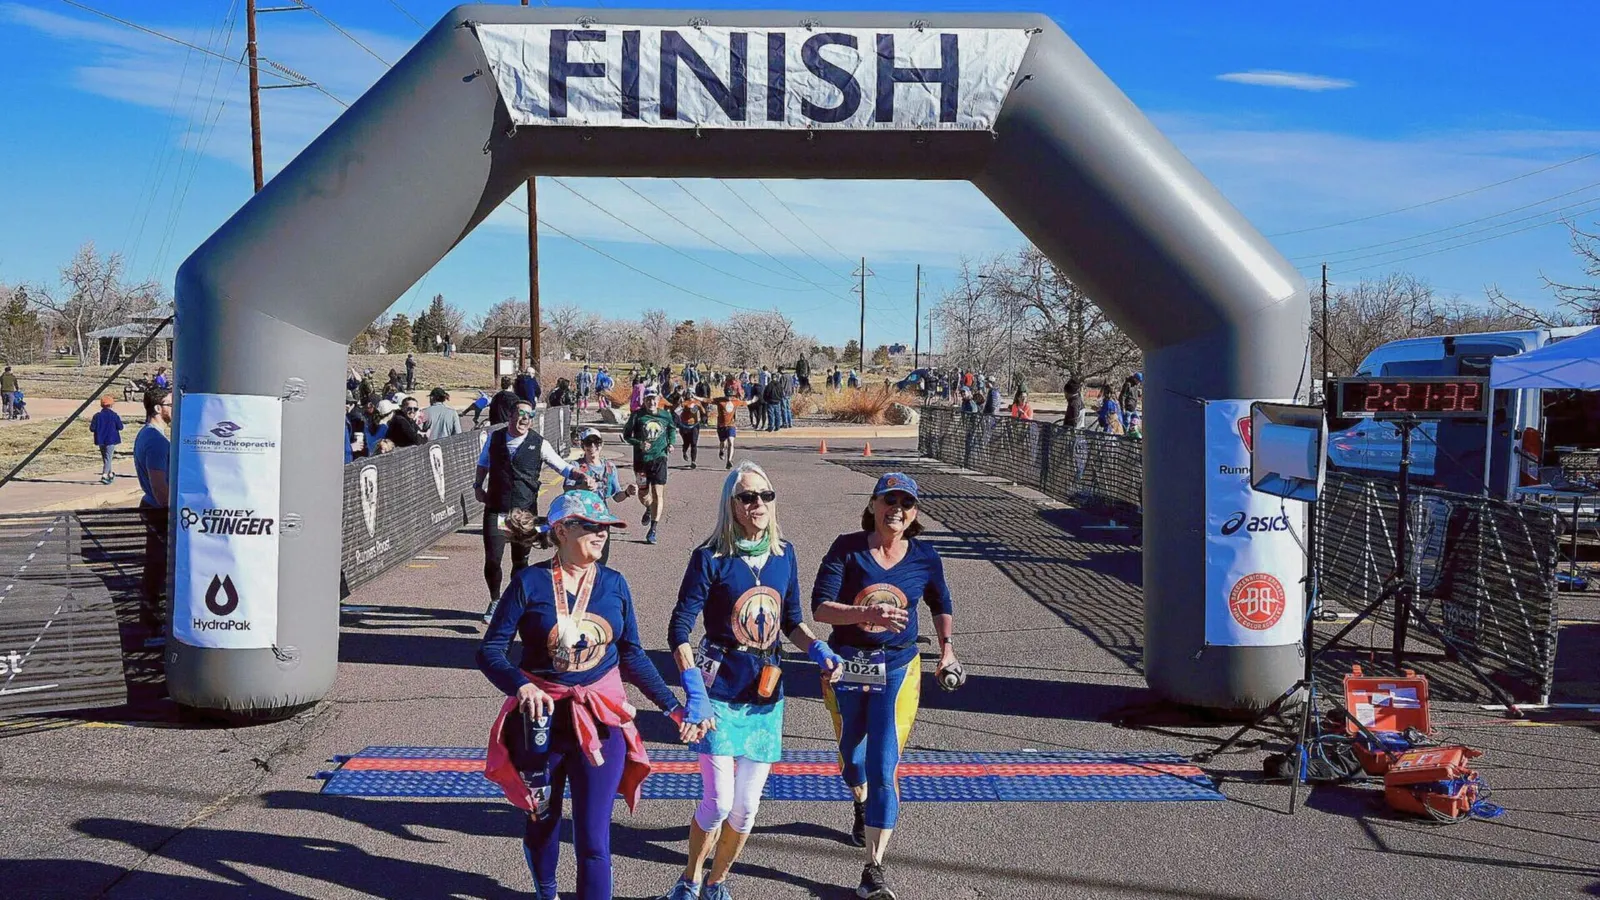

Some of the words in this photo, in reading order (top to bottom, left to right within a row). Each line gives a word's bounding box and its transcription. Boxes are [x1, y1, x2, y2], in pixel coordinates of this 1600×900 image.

[548, 28, 960, 124] FINISH
[223, 439, 276, 449] Chiropractic
[202, 508, 255, 517] HONEY
[198, 517, 274, 536] STINGER
[193, 618, 251, 632] HydraPak
[844, 661, 881, 676] 1024
